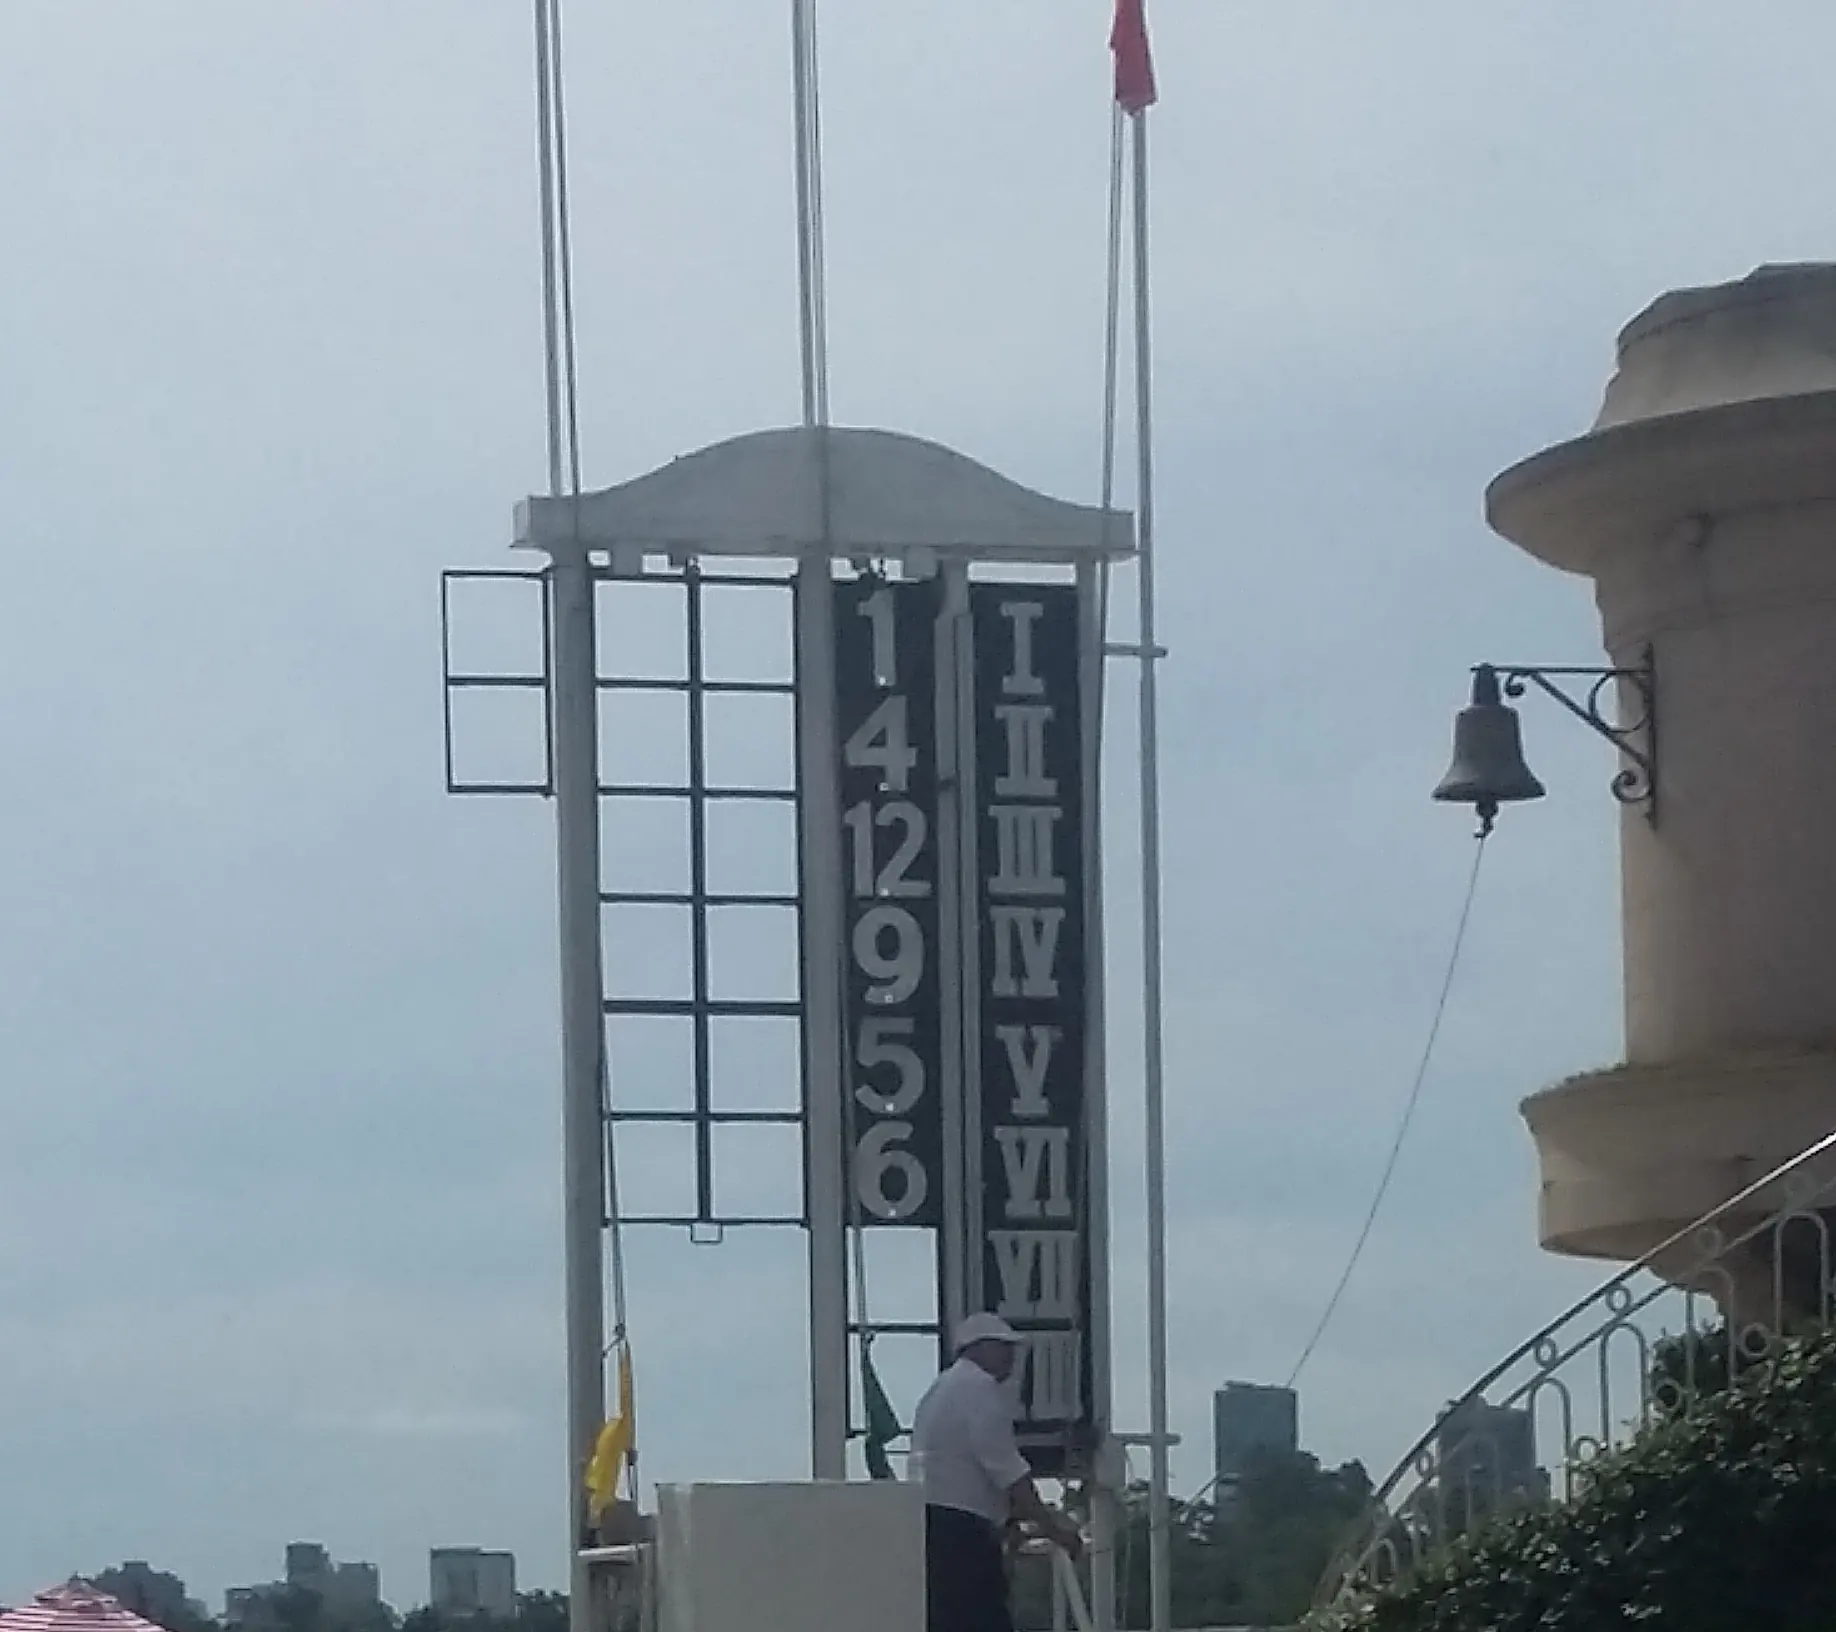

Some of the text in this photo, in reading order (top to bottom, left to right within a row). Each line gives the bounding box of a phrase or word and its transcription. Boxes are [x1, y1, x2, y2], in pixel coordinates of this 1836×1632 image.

[858, 589, 1045, 694] 1 I
[845, 695, 1058, 796] 4 II
[844, 800, 1066, 898] 12 III
[852, 905, 1066, 1003] 9 IV
[855, 1016, 1062, 1116] 5 V
[855, 1120, 1072, 1218] 6 VI
